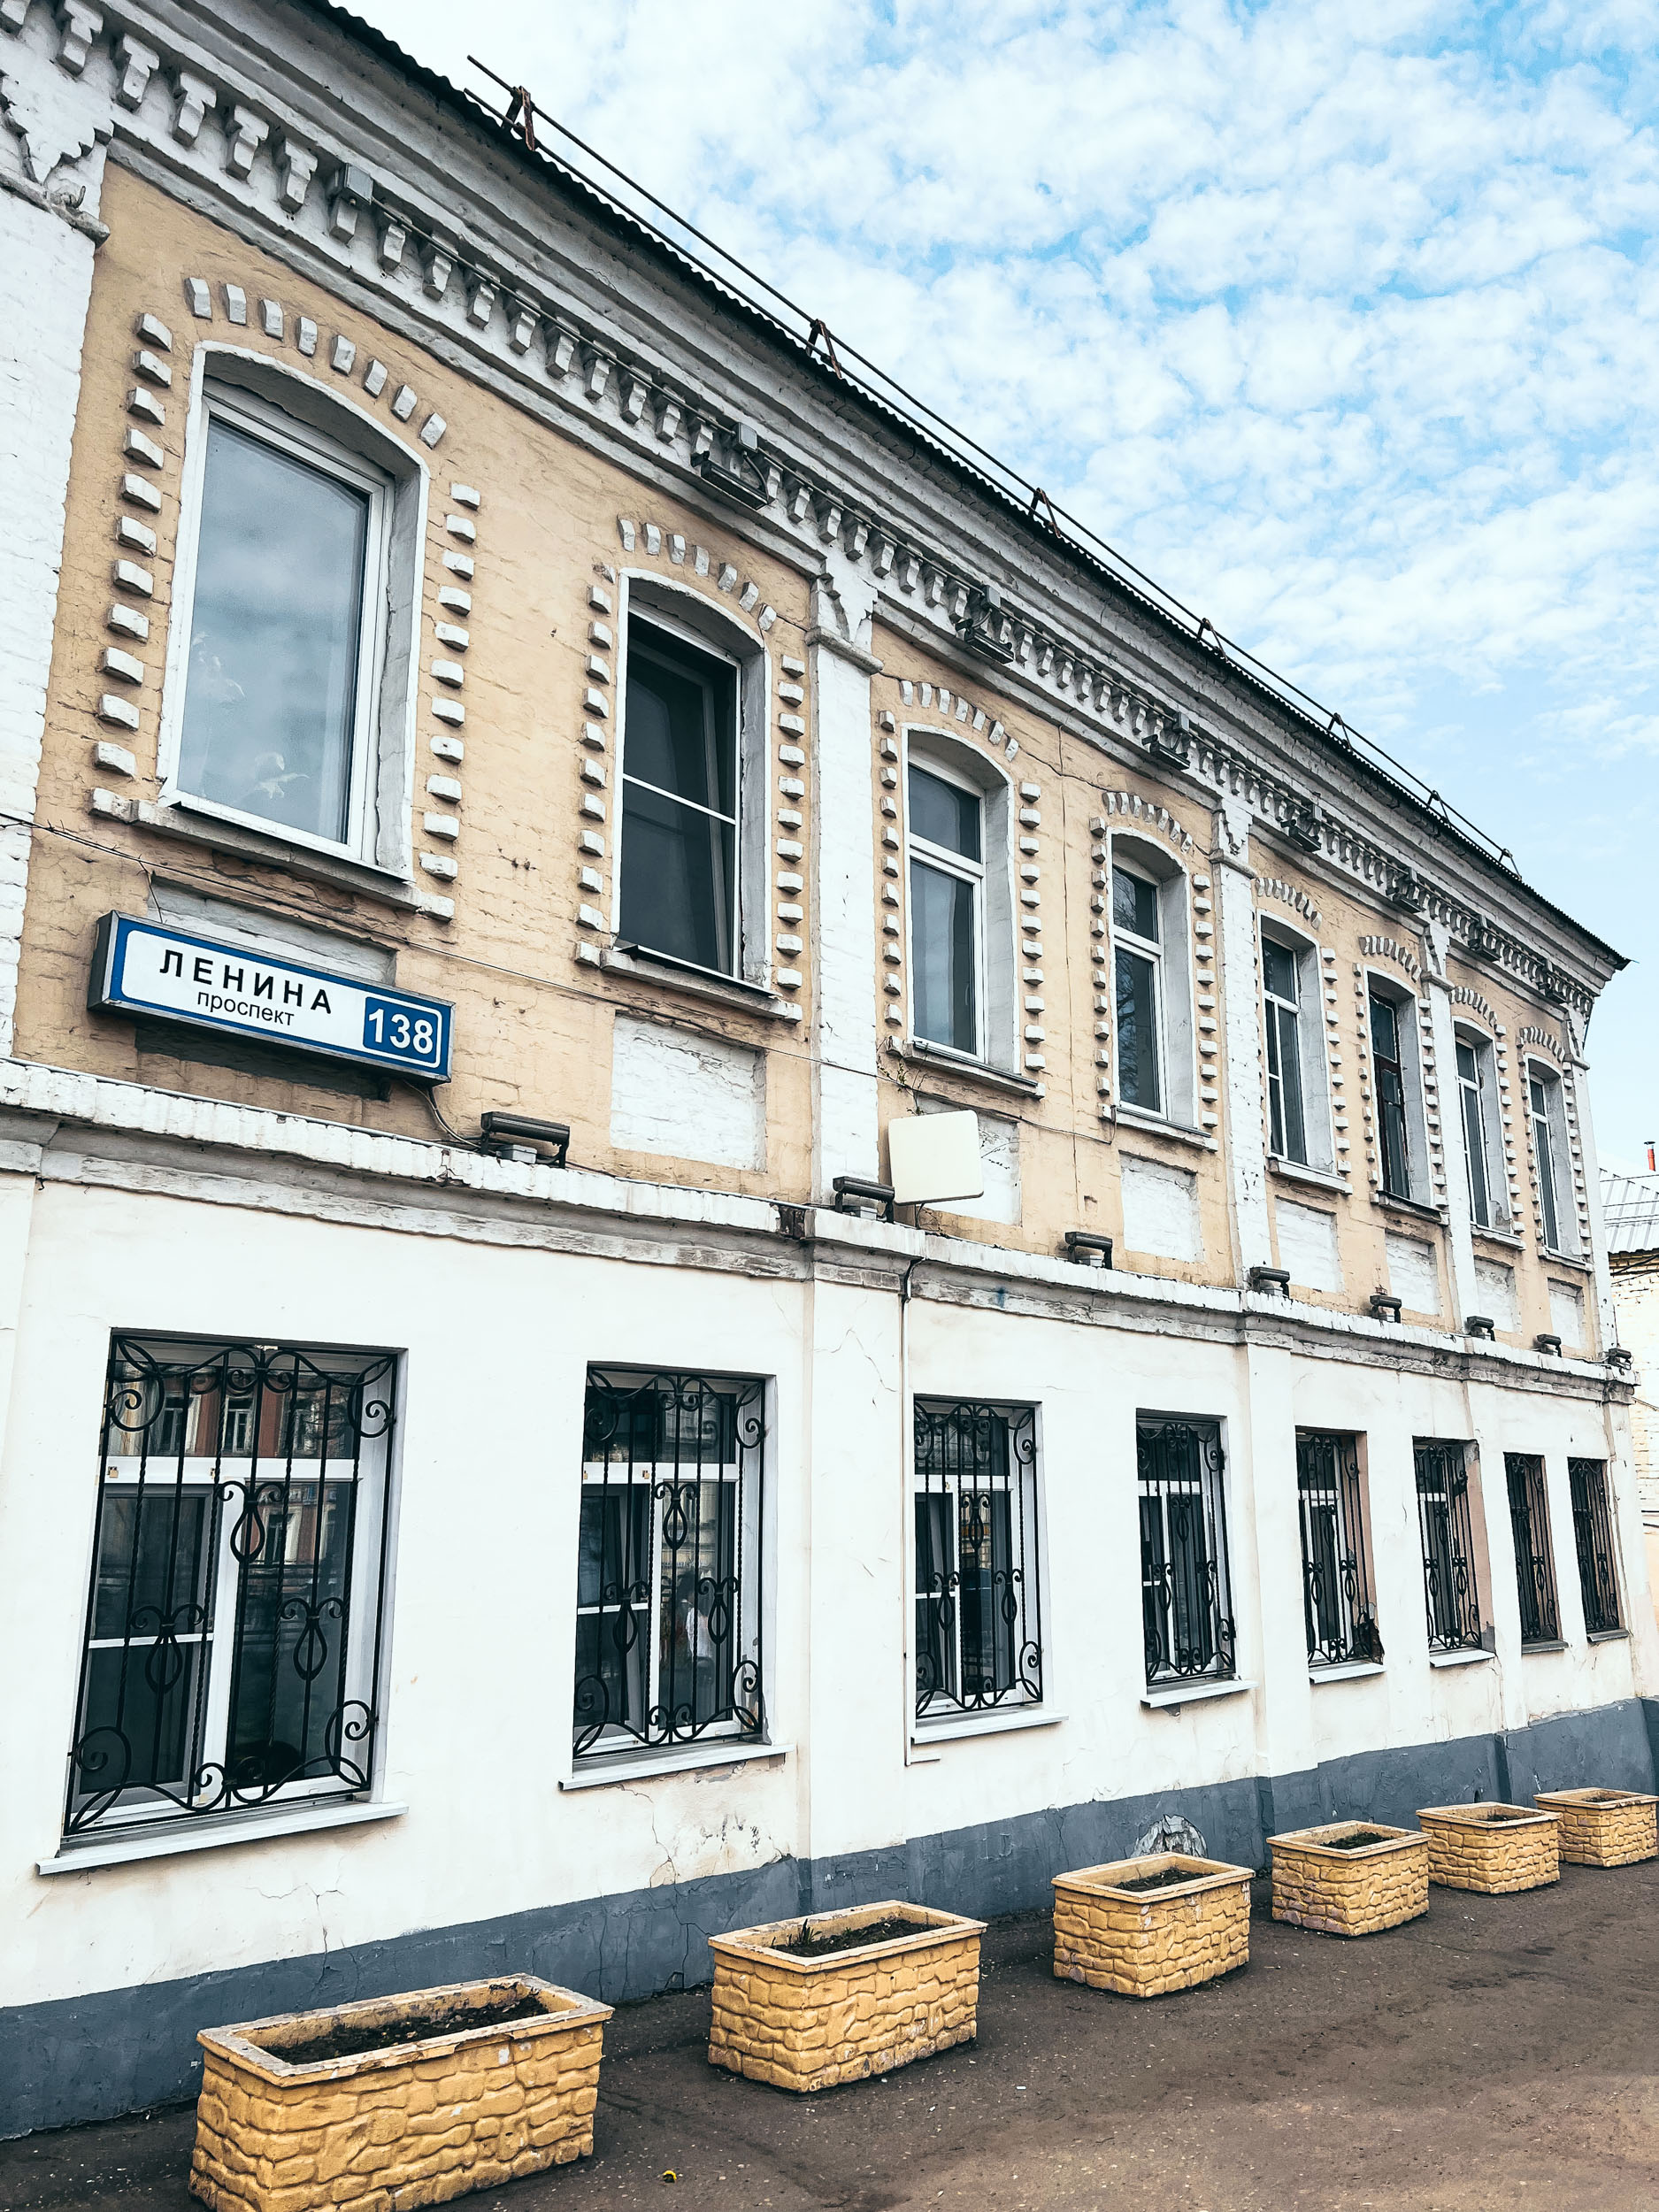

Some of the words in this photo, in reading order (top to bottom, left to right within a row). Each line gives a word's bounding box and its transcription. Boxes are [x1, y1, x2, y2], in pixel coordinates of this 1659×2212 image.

[159, 949, 332, 1014] ЛЕНИНА
[197, 991, 295, 1025] проспект
[367, 1008, 434, 1055] 138
